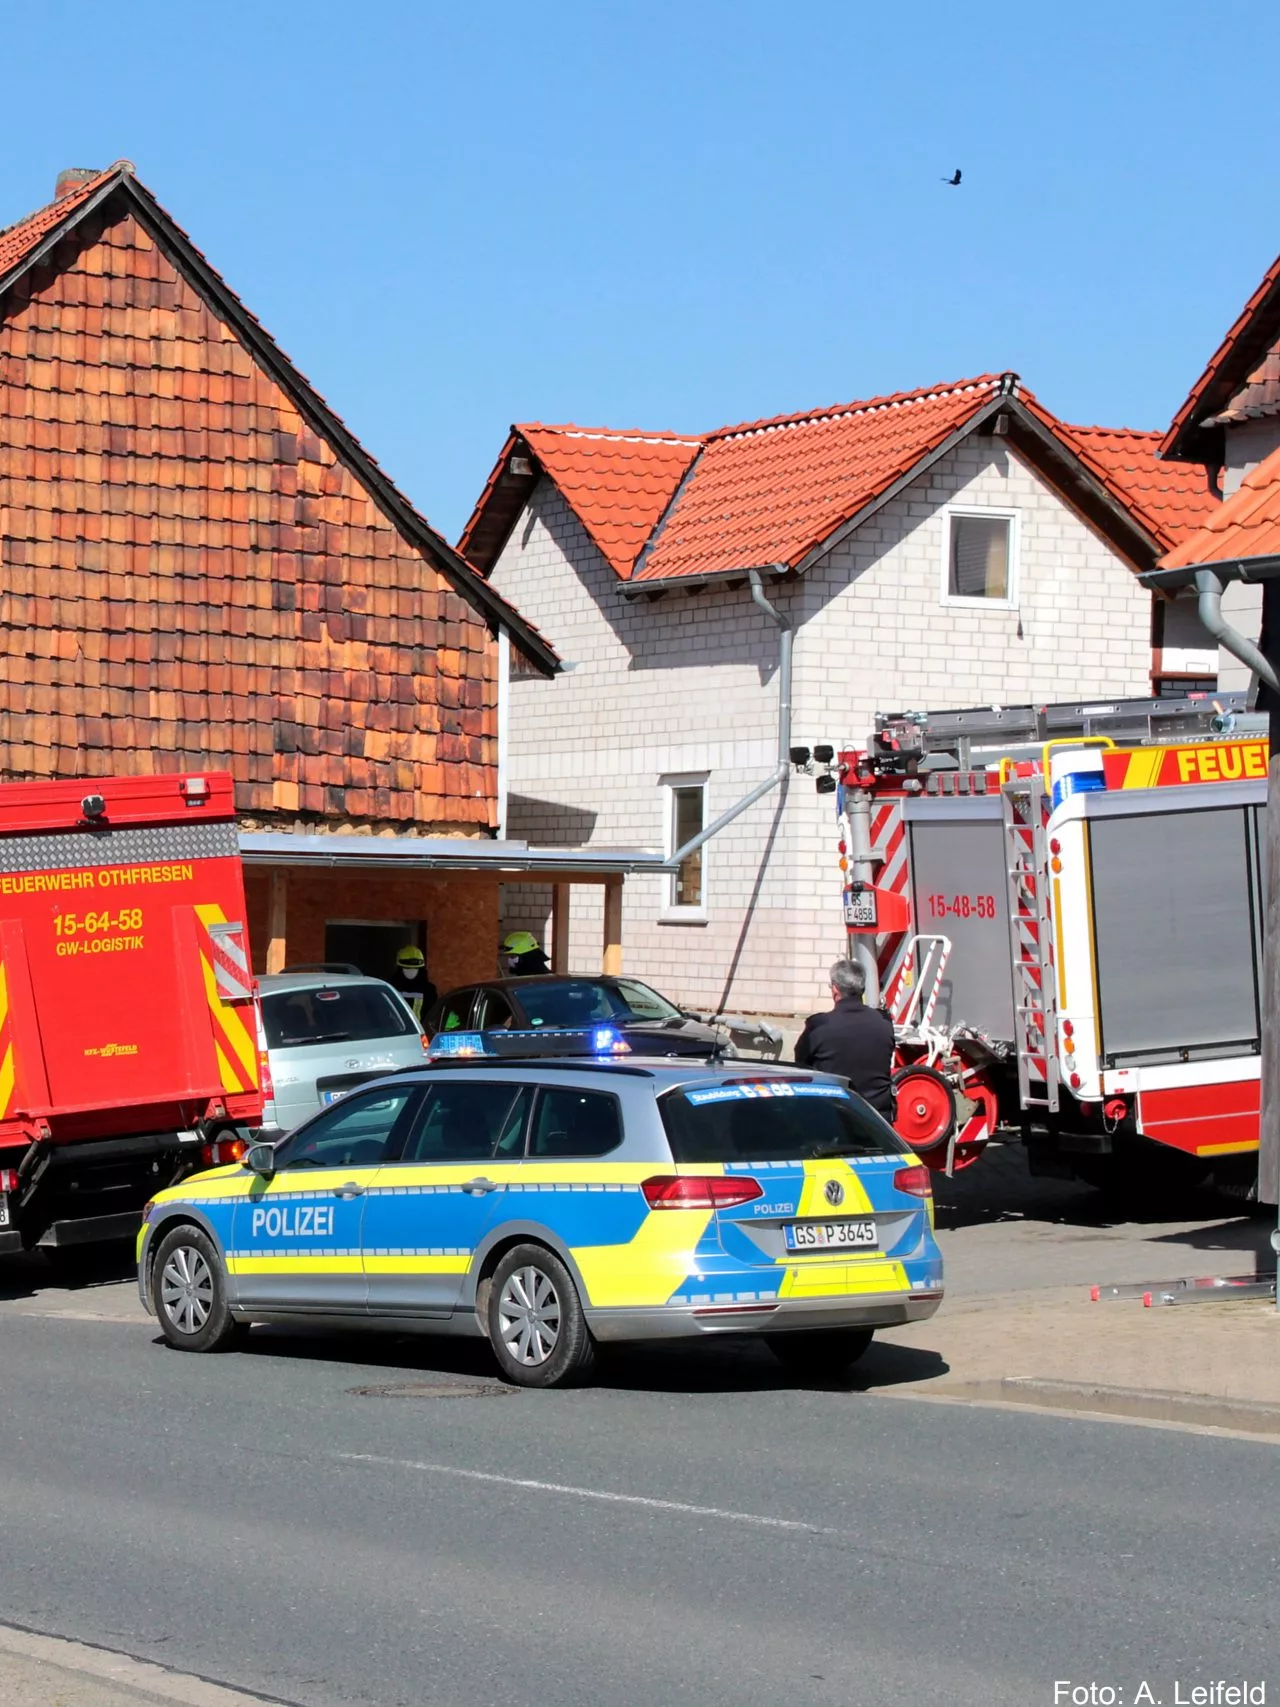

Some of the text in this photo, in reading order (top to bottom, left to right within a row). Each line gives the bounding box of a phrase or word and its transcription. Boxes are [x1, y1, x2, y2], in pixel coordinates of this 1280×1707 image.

[1177, 745, 1269, 783] FEUE
[98, 865, 194, 888] OTHFRESEN
[854, 906, 873, 921] 4858
[928, 894, 996, 919] 15-48-58
[53, 908, 144, 936] 15-64-58
[56, 935, 145, 957] GW-LOGISTIK
[754, 1203, 794, 1214] POLIZEI
[252, 1206, 335, 1237] POLIZEI
[795, 1222, 874, 1244] GS P 3645
